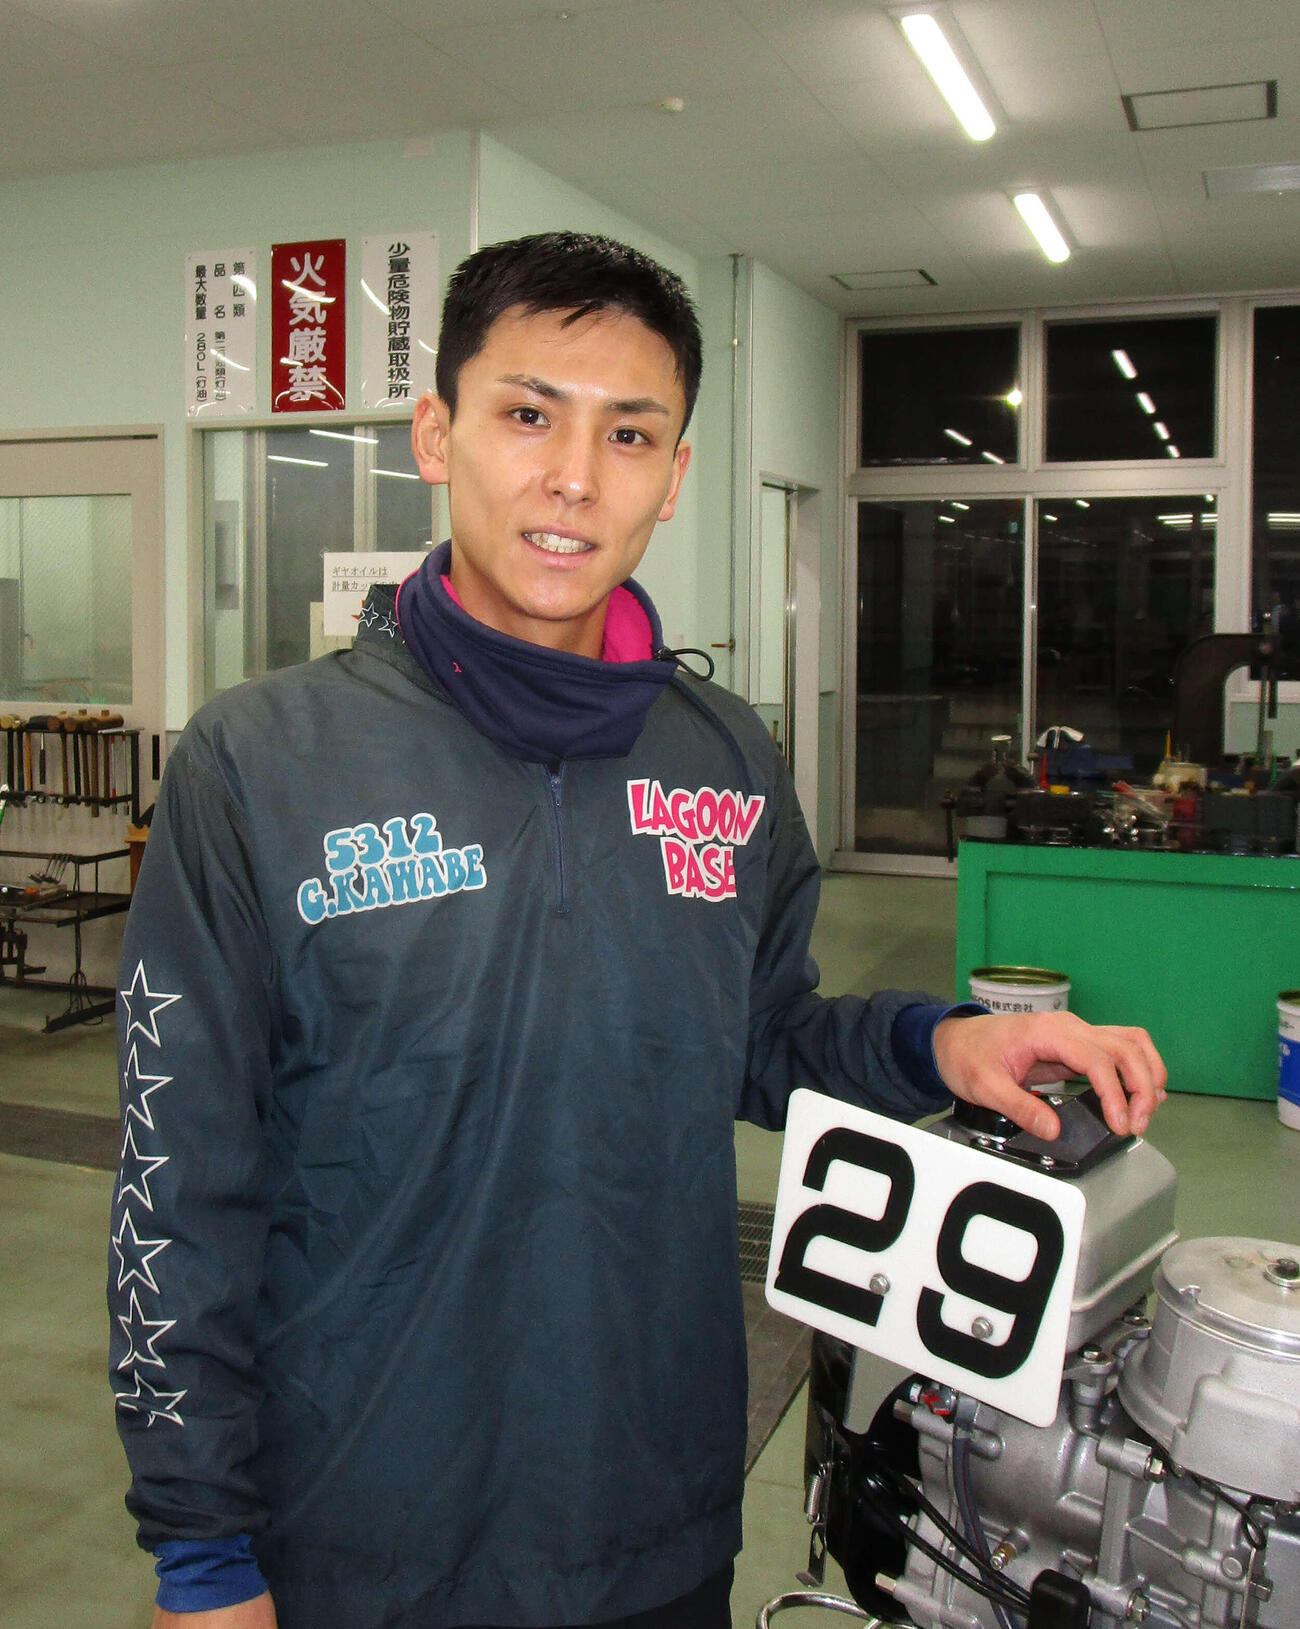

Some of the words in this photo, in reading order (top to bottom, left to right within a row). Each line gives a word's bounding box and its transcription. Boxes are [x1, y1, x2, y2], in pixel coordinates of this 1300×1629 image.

[289, 252, 327, 401] 火気厳禁
[387, 241, 411, 399] 少量危険物貯蔵取扱所
[324, 813, 442, 873] 5312
[627, 779, 765, 845] LAGOON
[297, 844, 487, 925] G.KAWABE
[660, 836, 737, 902] BASE
[774, 1127, 1064, 1379] 29
